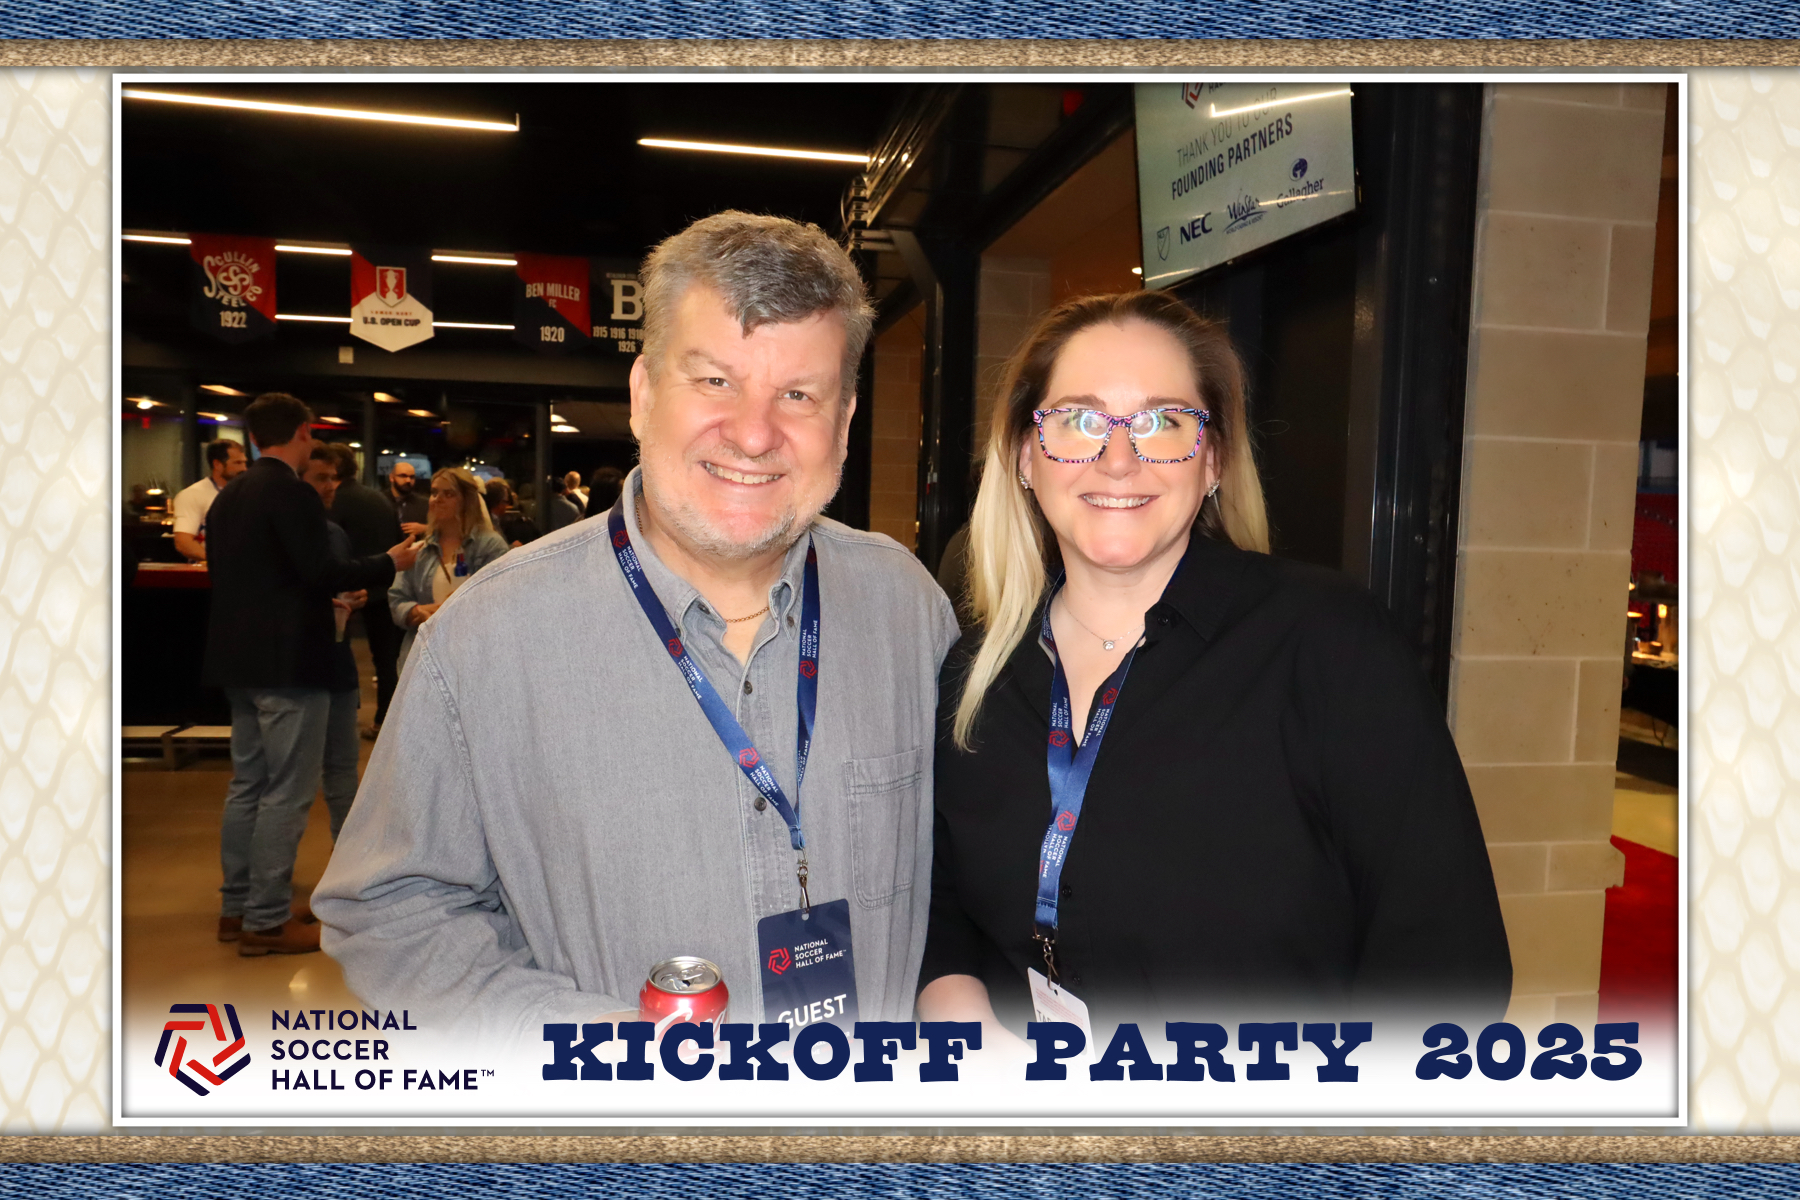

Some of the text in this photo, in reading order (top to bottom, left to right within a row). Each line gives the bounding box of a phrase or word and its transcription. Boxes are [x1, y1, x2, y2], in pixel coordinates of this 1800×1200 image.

[1177, 131, 1209, 168] THANK
[1211, 115, 1233, 146] YOU
[1172, 112, 1293, 200] FOUNDING PARTNERS
[1276, 177, 1324, 209] Gallagher
[1180, 211, 1213, 245] NEC
[525, 282, 580, 301] BEN MILLER
[549, 298, 557, 308] FC
[610, 278, 644, 320] B
[220, 310, 247, 328] 1922
[380, 317, 402, 326] OPEN
[404, 318, 421, 327] CUP
[540, 325, 565, 342] 1920
[593, 325, 608, 338] 1915
[610, 327, 626, 340] 1916
[618, 340, 636, 353] 1926
[618, 552, 638, 589] HALL OF FAME
[622, 549, 635, 571] SOCCER
[627, 546, 642, 572] NATIONAL
[678, 661, 702, 700] HALL OF FAME
[680, 659, 696, 681] SOCCER
[683, 656, 703, 683] NATIONAL
[750, 772, 779, 806] HALL OF FAME
[755, 769, 771, 792] SOCCER
[760, 765, 779, 793] NATIONAL
[1049, 833, 1057, 849] HALL
[1052, 835, 1063, 861] SOCCER
[1055, 836, 1068, 867] NATIONAL
[1047, 850, 1053, 861] OF
[794, 939, 828, 952] NATIONAL
[795, 948, 823, 961] SOCCER
[795, 958, 813, 969] HALL
[815, 955, 824, 963] OF
[777, 993, 847, 1030] GUEST
